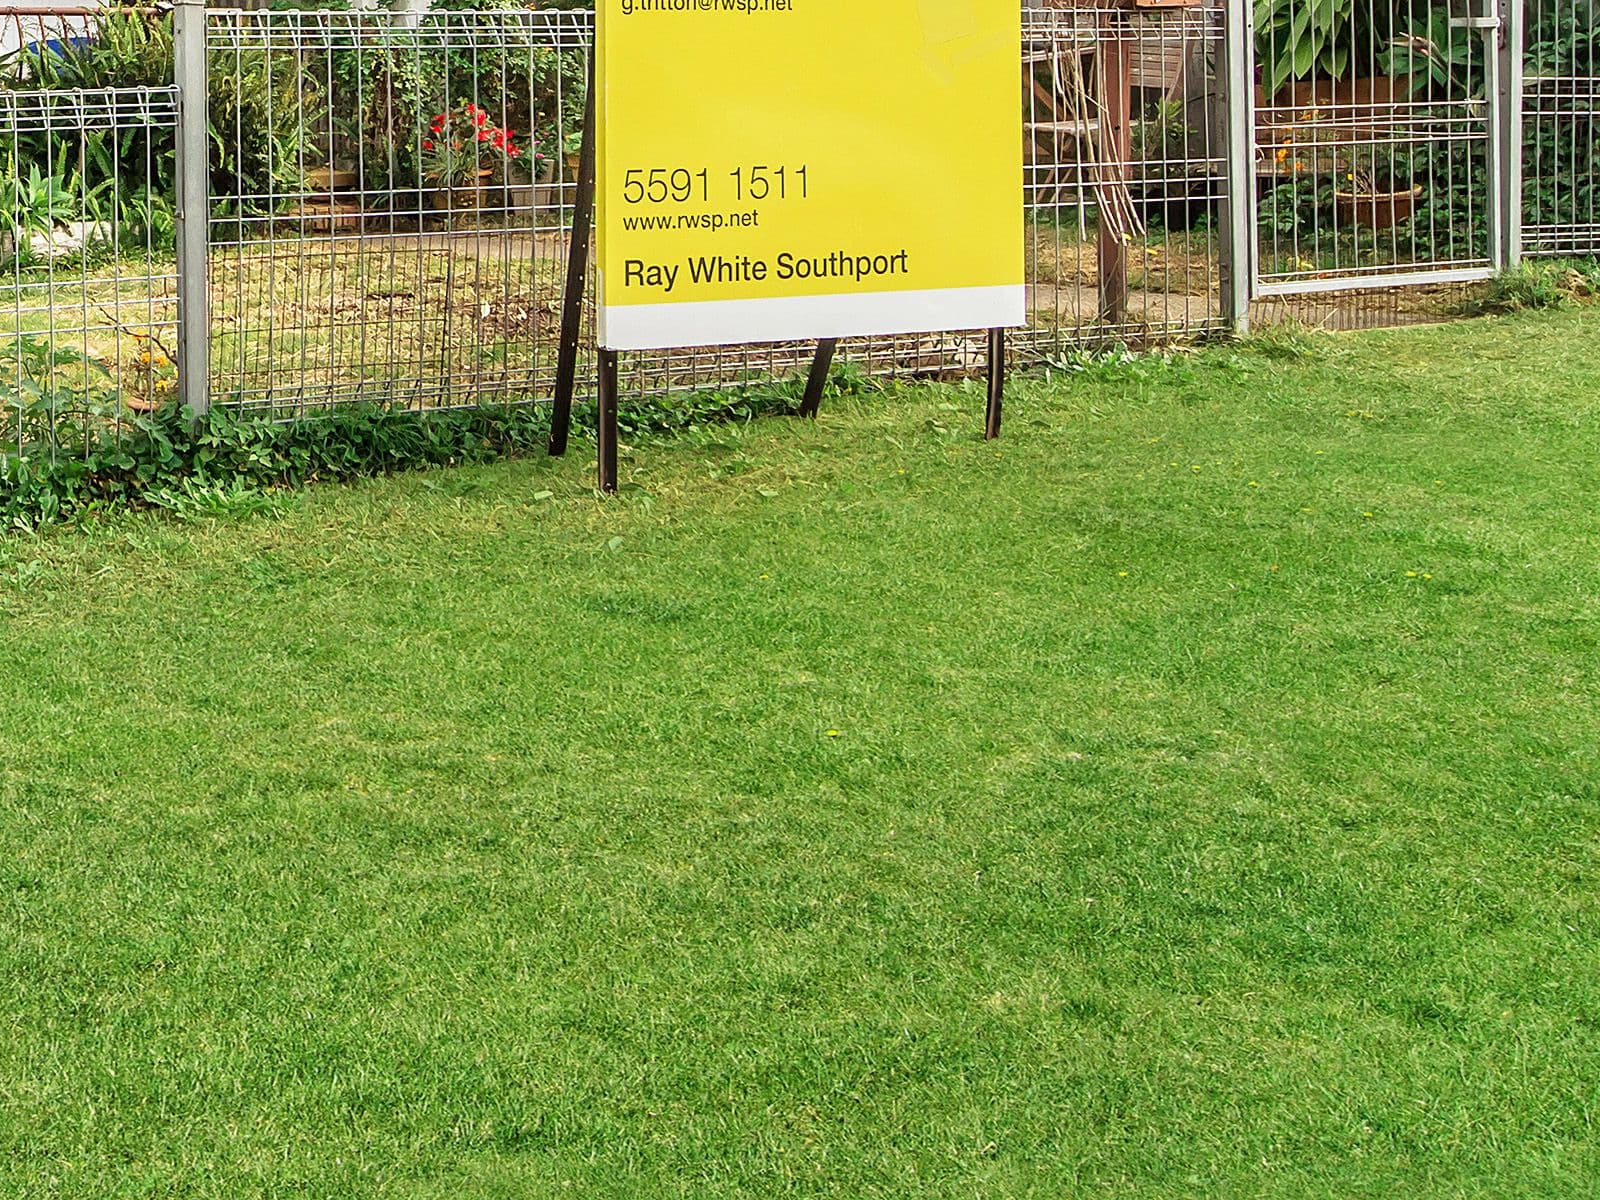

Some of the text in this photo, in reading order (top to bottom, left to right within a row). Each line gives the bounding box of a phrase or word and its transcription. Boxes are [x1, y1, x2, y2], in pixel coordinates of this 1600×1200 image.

[623, 164, 808, 203] 5591 1511
[623, 209, 759, 233] www.rwsp.net
[624, 249, 909, 292] Ray White Southport
